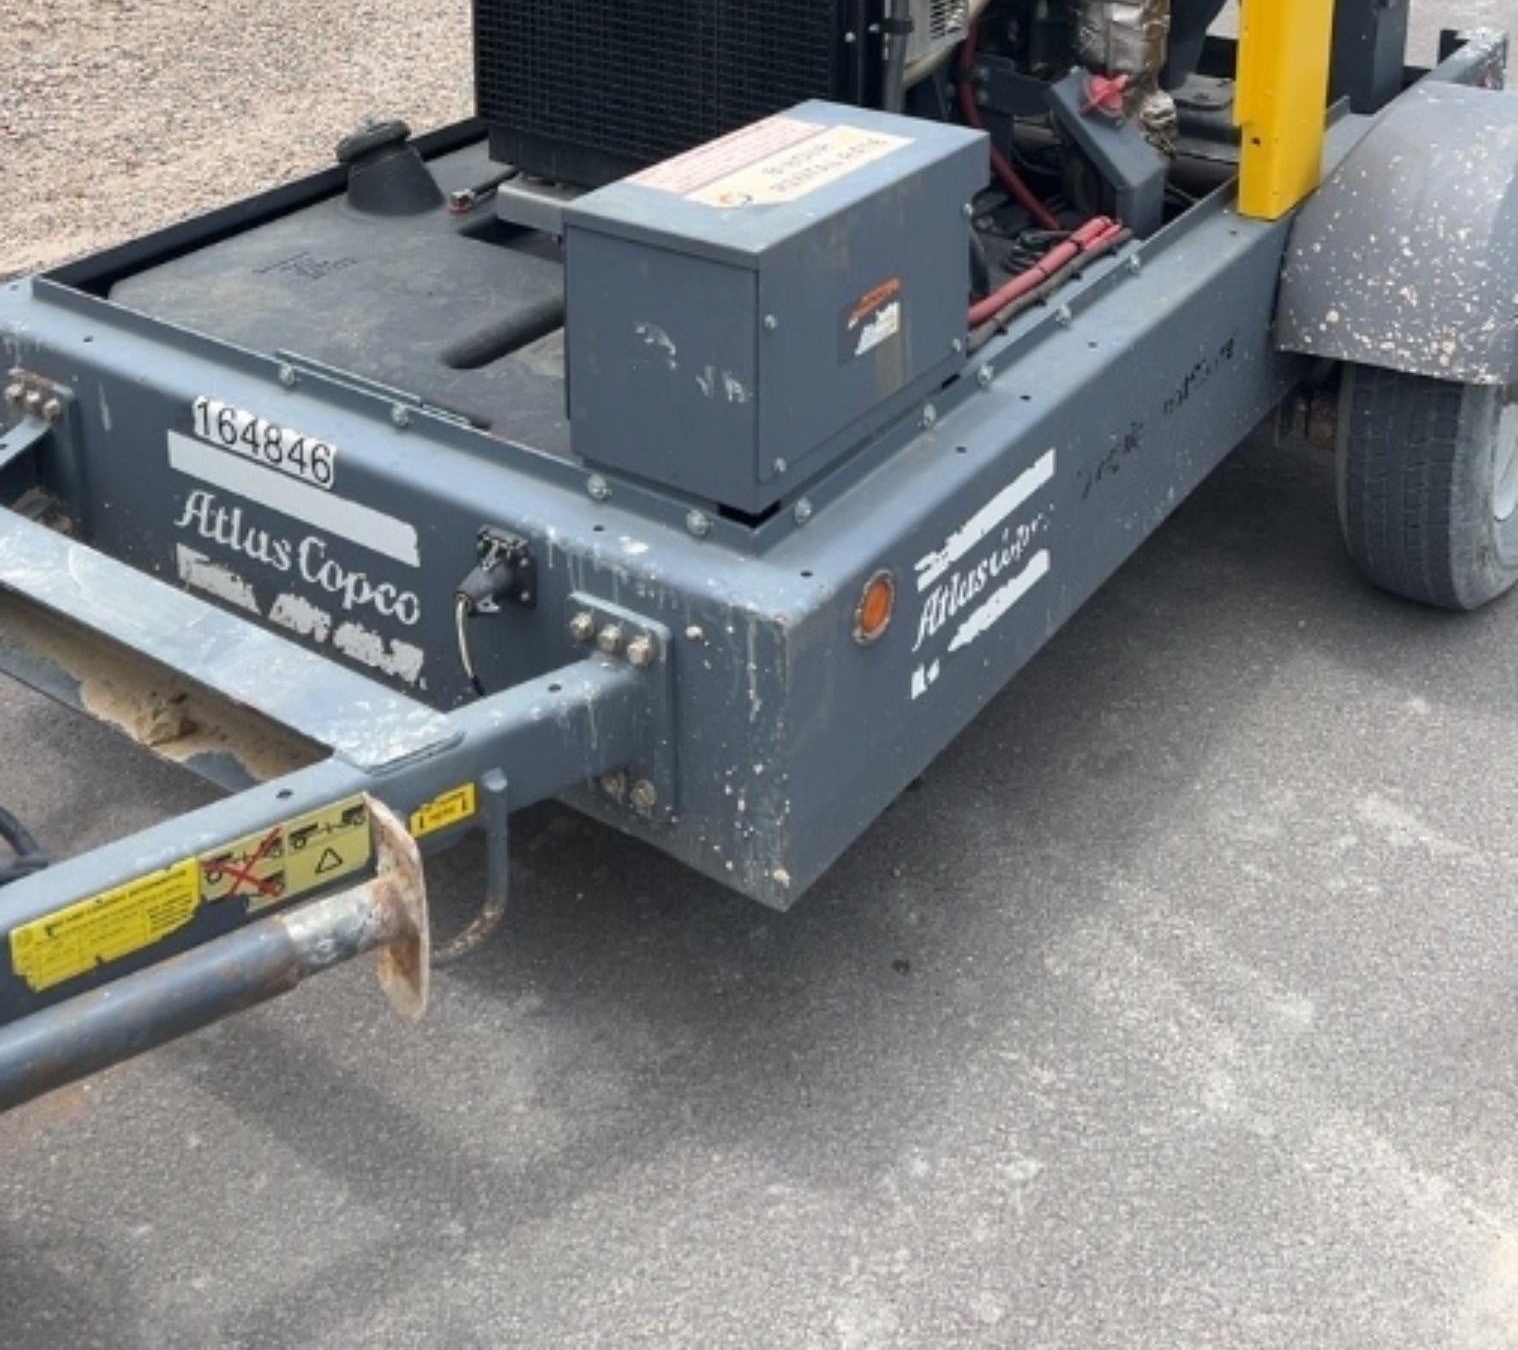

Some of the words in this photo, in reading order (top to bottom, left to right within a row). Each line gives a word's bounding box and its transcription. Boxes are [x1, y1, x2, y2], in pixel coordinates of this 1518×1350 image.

[196, 399, 332, 484] 164846
[174, 489, 292, 572] Atlas
[297, 535, 420, 626] Copco
